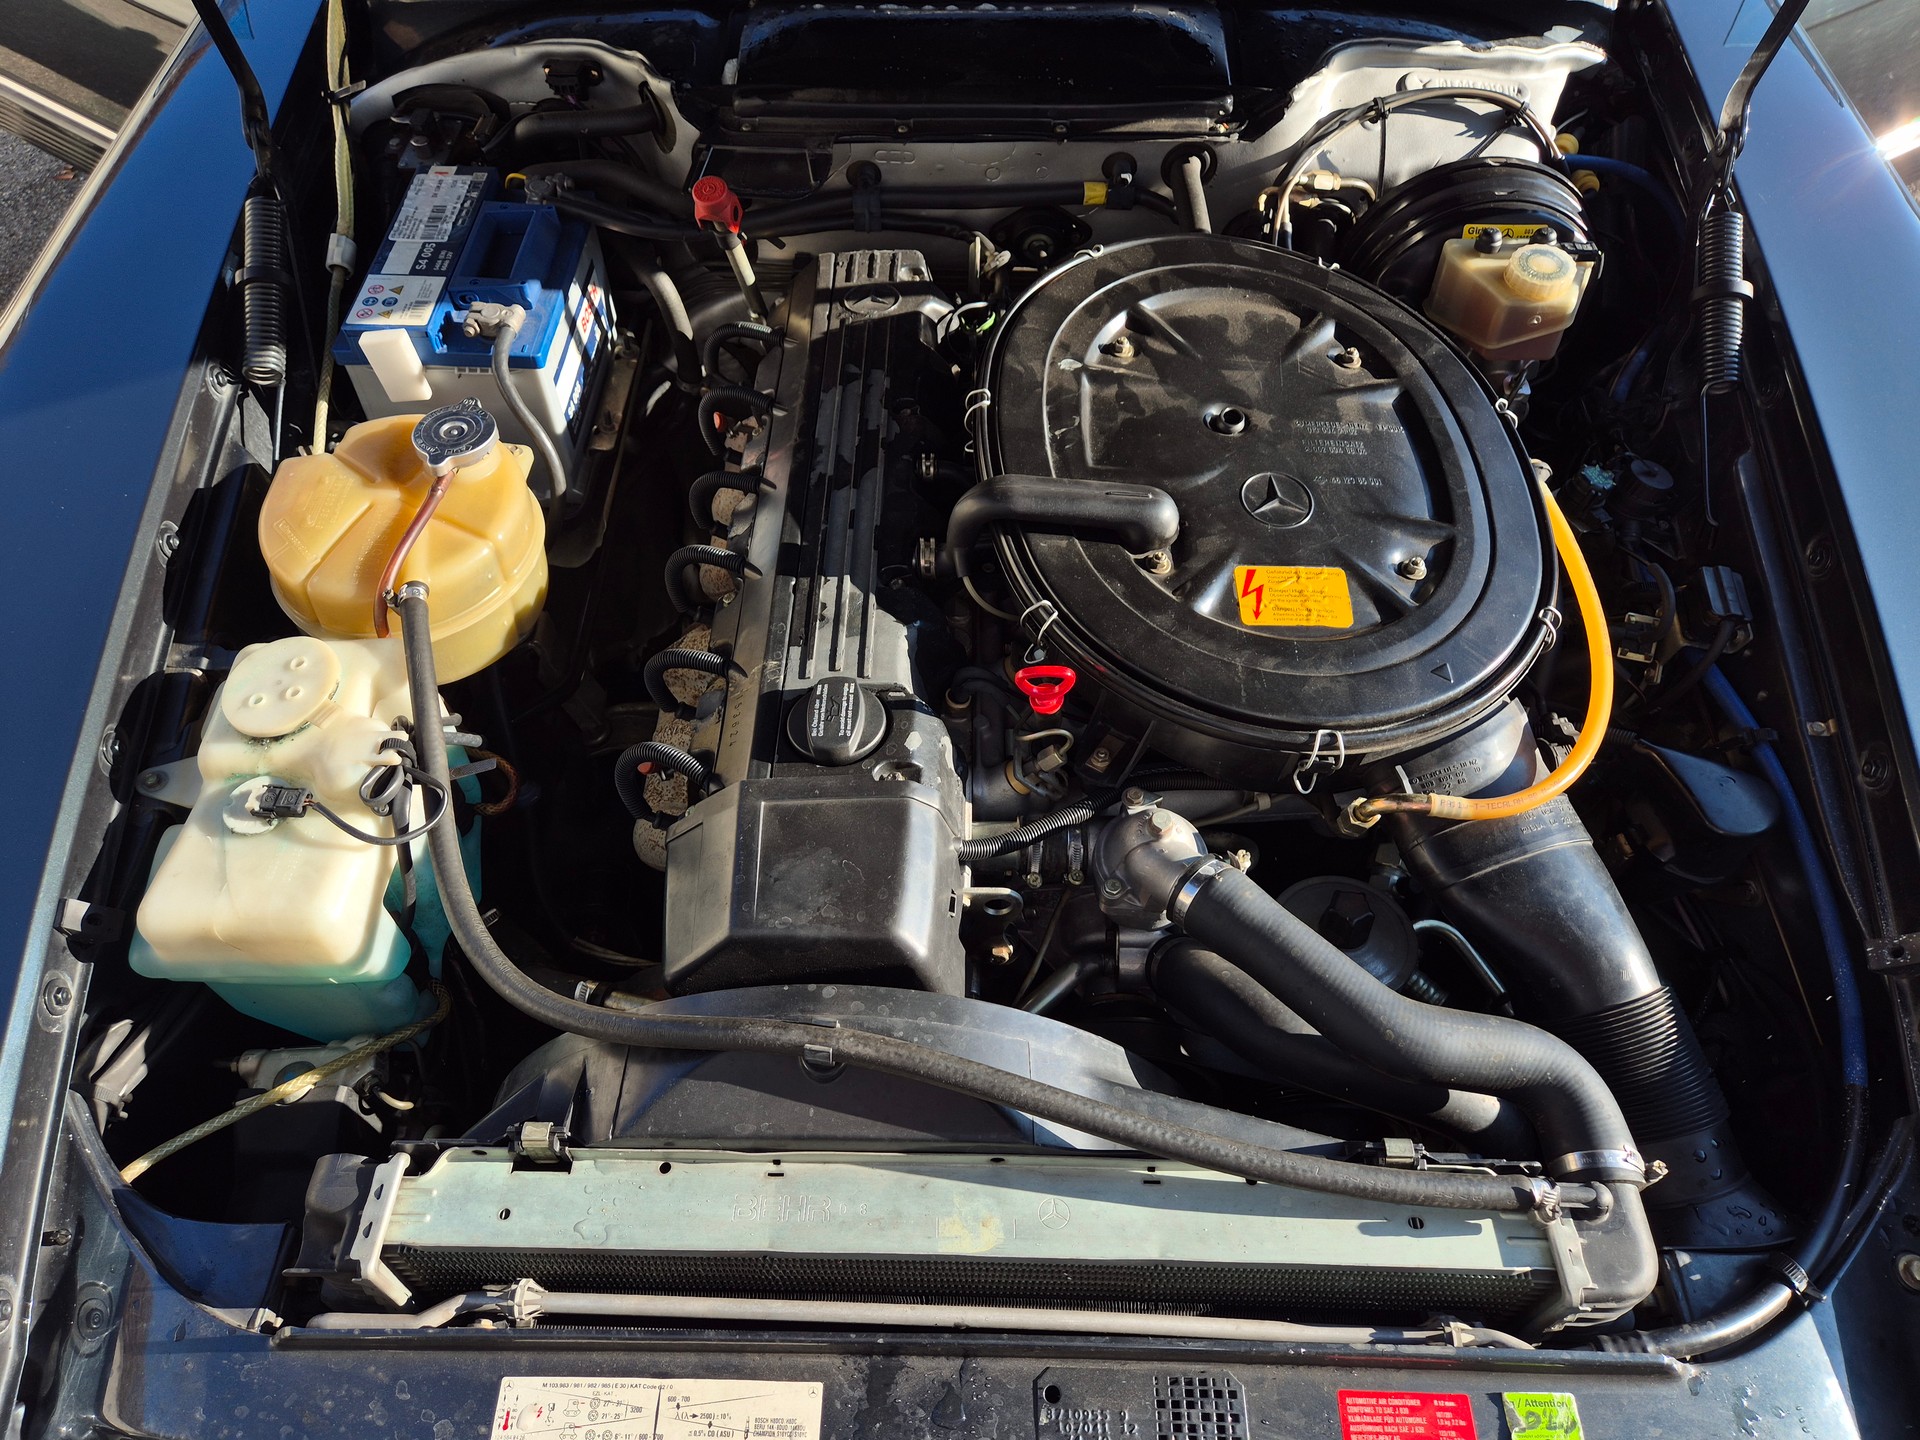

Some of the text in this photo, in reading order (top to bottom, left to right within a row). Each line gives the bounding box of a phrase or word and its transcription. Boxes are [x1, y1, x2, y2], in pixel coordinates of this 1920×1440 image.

[415, 242, 437, 271] S4 005
[838, 729, 845, 737] To
[730, 1193, 832, 1223] BEHR
[1345, 1397, 1421, 1407] AUTOMOTIVE AIR CONDITIONER
[1524, 1398, 1568, 1408] Attention
[1346, 1406, 1375, 1414] CONFORMS
[1383, 1407, 1394, 1415] SAE
[1349, 1424, 1384, 1433] AUSFÜHRUNG
[1384, 1425, 1399, 1433] NACH
[1399, 1426, 1410, 1434] SAE
